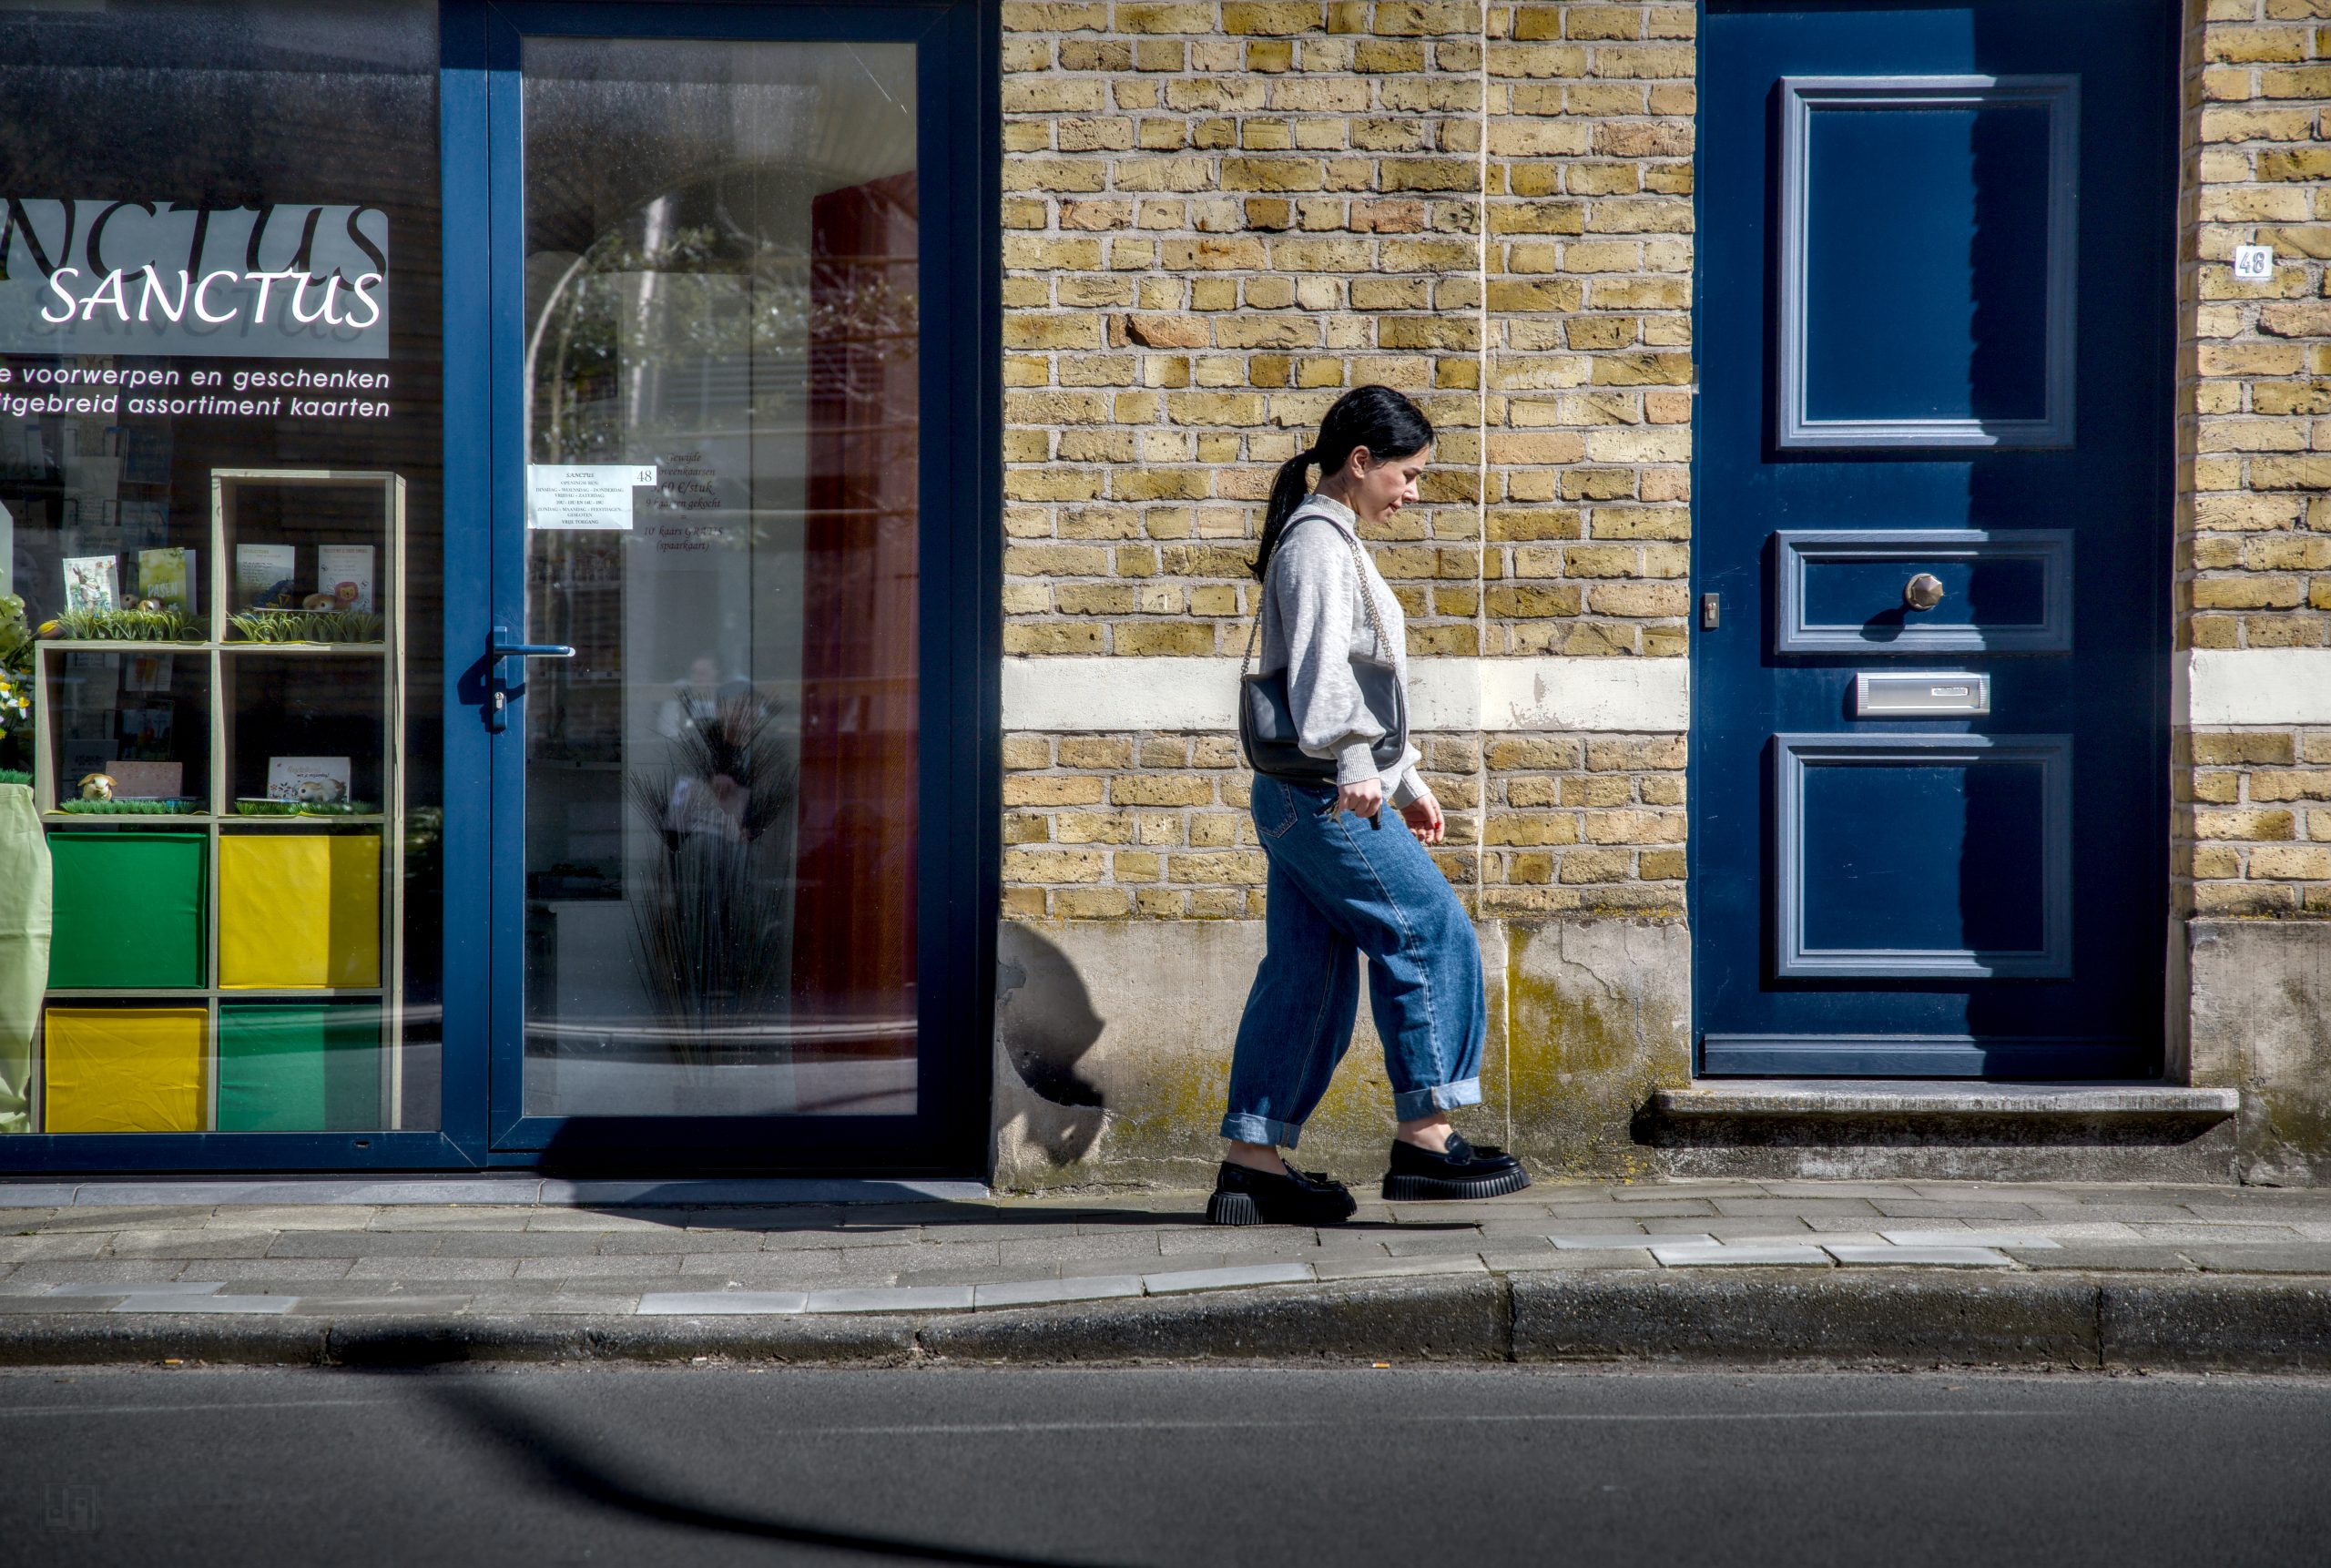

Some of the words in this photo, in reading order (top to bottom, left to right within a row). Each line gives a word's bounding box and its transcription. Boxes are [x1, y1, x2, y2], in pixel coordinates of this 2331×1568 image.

[2239, 251, 2265, 274] 48
[41, 264, 382, 328] SANCTUS
[23, 368, 179, 388] voorwerpen
[191, 370, 222, 386] en
[233, 369, 390, 391] geschenken
[128, 395, 280, 414] assortiment
[290, 397, 390, 417] kaarten
[636, 470, 652, 482] 48
[658, 466, 716, 478] oveenkaarsen
[687, 496, 721, 510] gekocht
